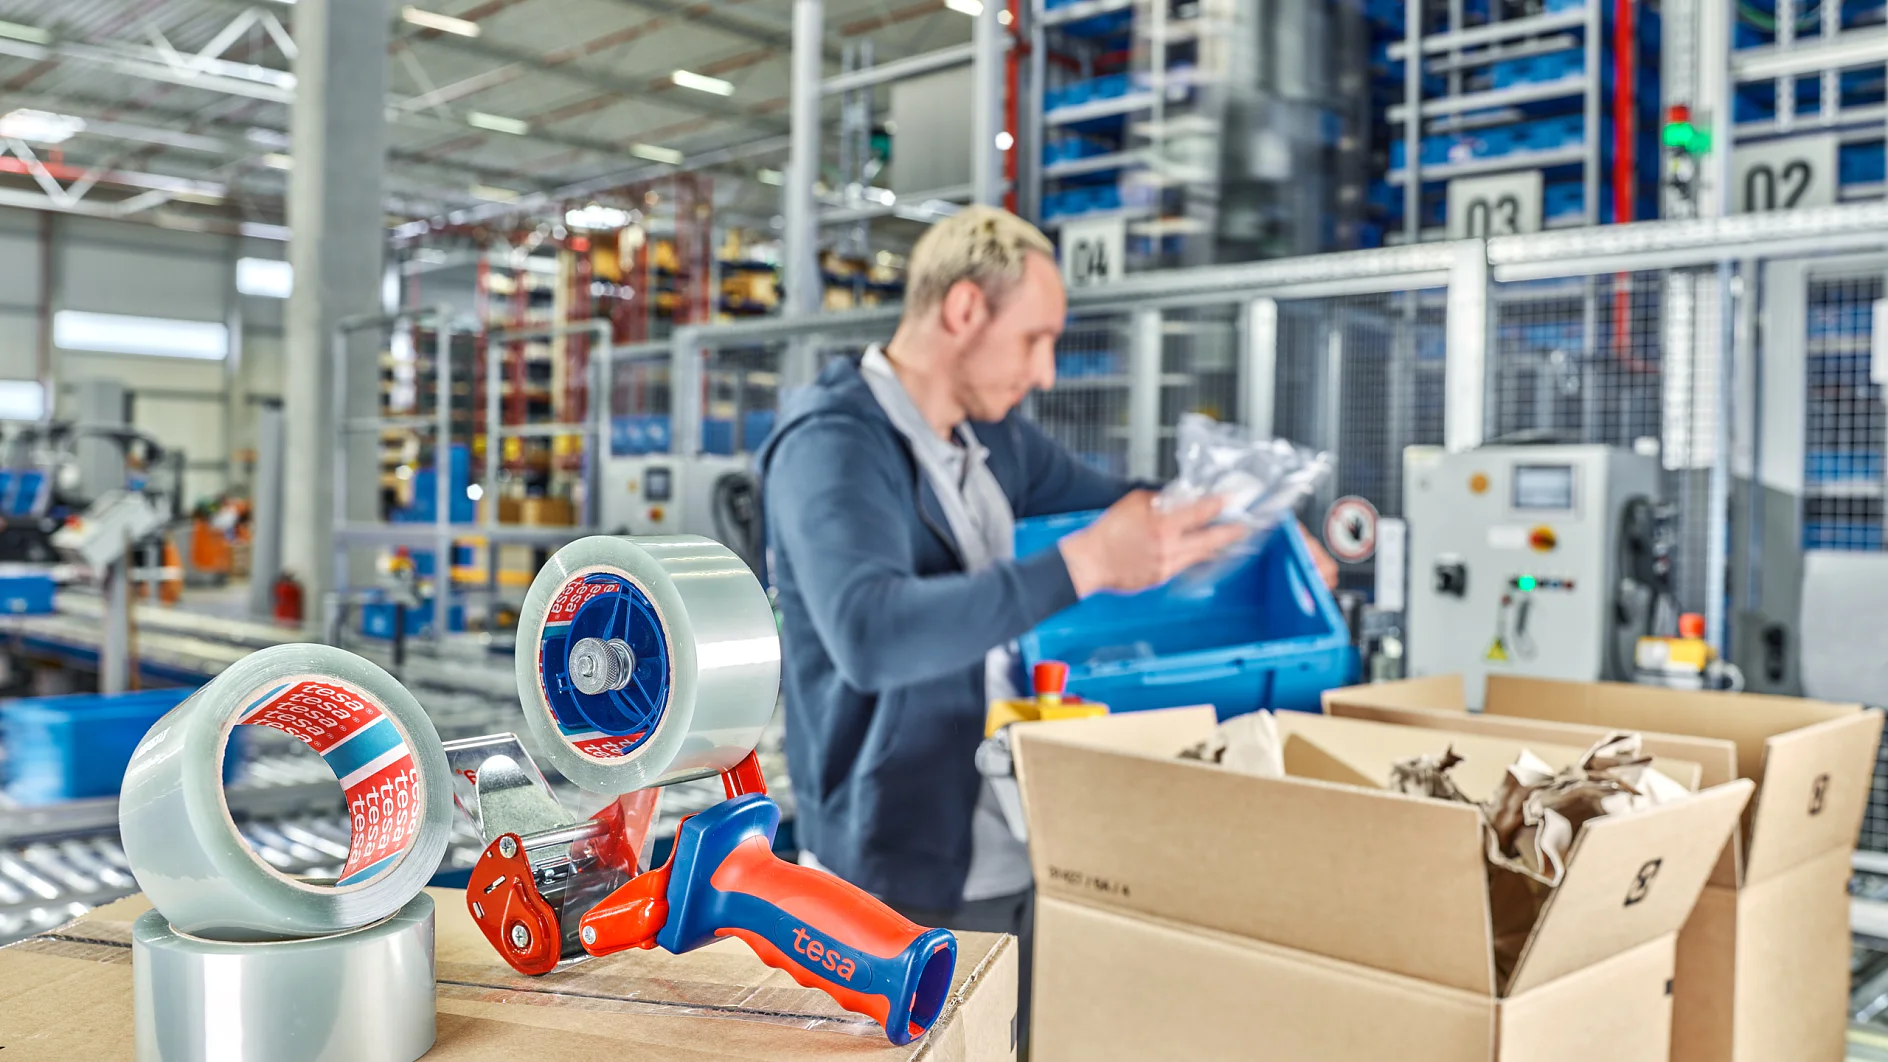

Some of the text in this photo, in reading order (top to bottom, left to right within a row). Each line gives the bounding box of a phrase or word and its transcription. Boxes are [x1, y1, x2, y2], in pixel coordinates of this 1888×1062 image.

[1745, 161, 1813, 212] 02
[565, 582, 588, 613] esa
[349, 794, 366, 865] tesa
[363, 785, 380, 858] tesa
[377, 777, 394, 850] tesa
[392, 769, 409, 843] tesa
[792, 927, 856, 982] tesa
